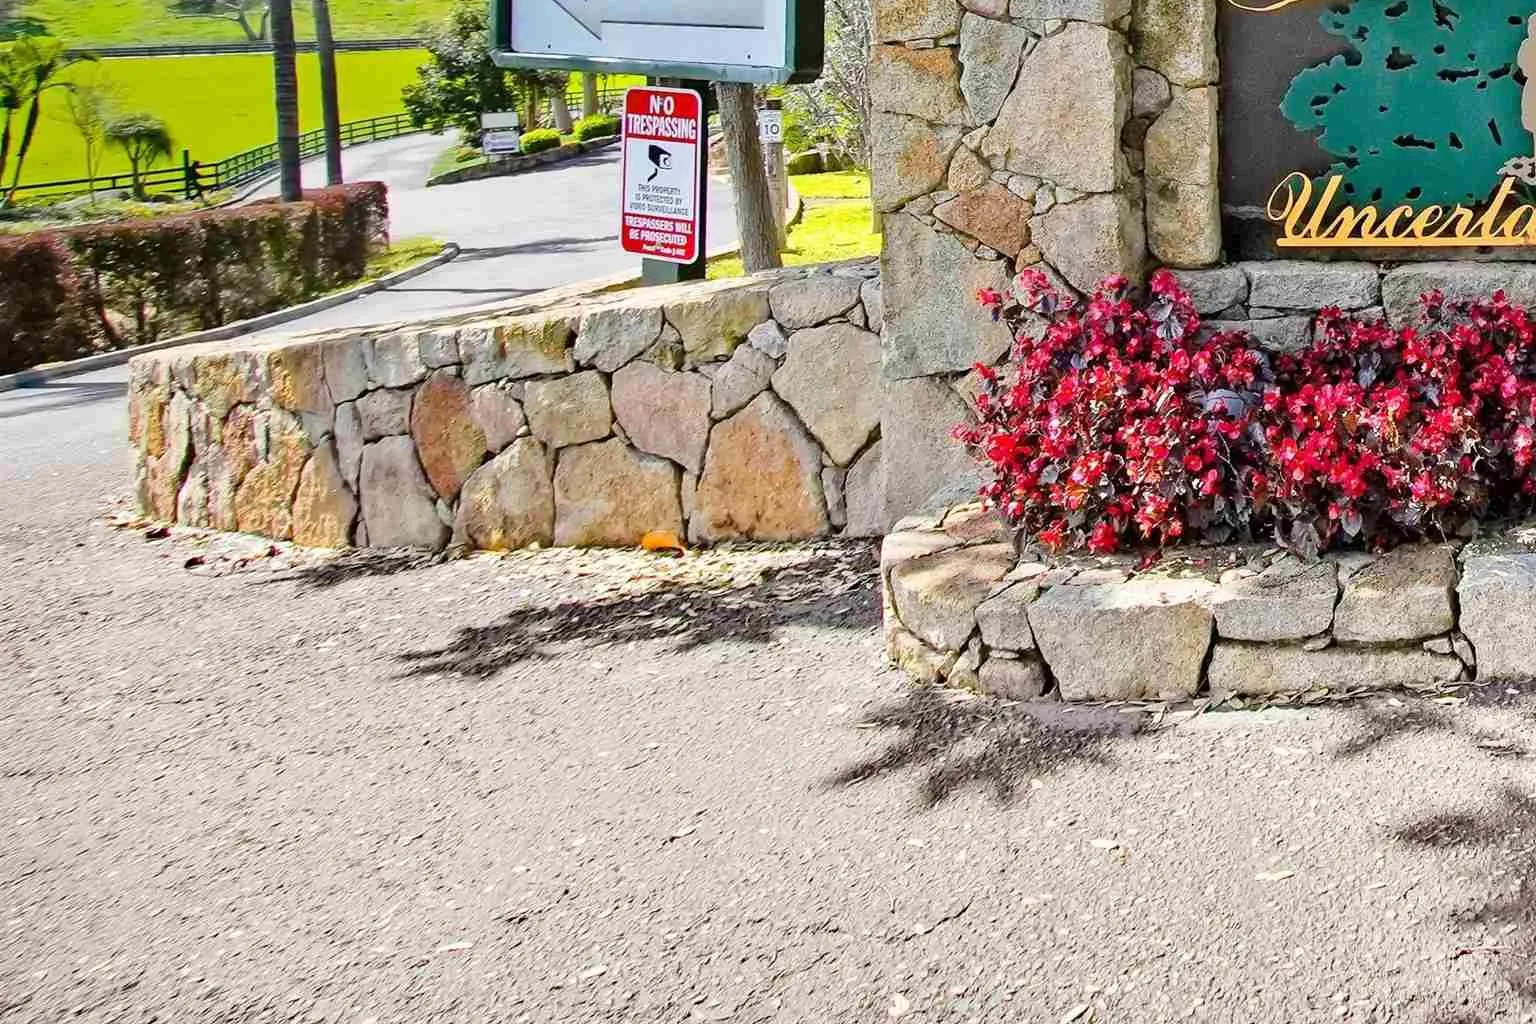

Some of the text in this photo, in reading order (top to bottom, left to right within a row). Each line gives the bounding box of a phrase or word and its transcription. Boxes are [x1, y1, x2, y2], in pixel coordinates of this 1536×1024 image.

[649, 94, 675, 115] NO
[627, 113, 697, 140] TRESPASSING
[625, 215, 674, 232] TRESPASSERS
[640, 230, 688, 247] PROSECUTED
